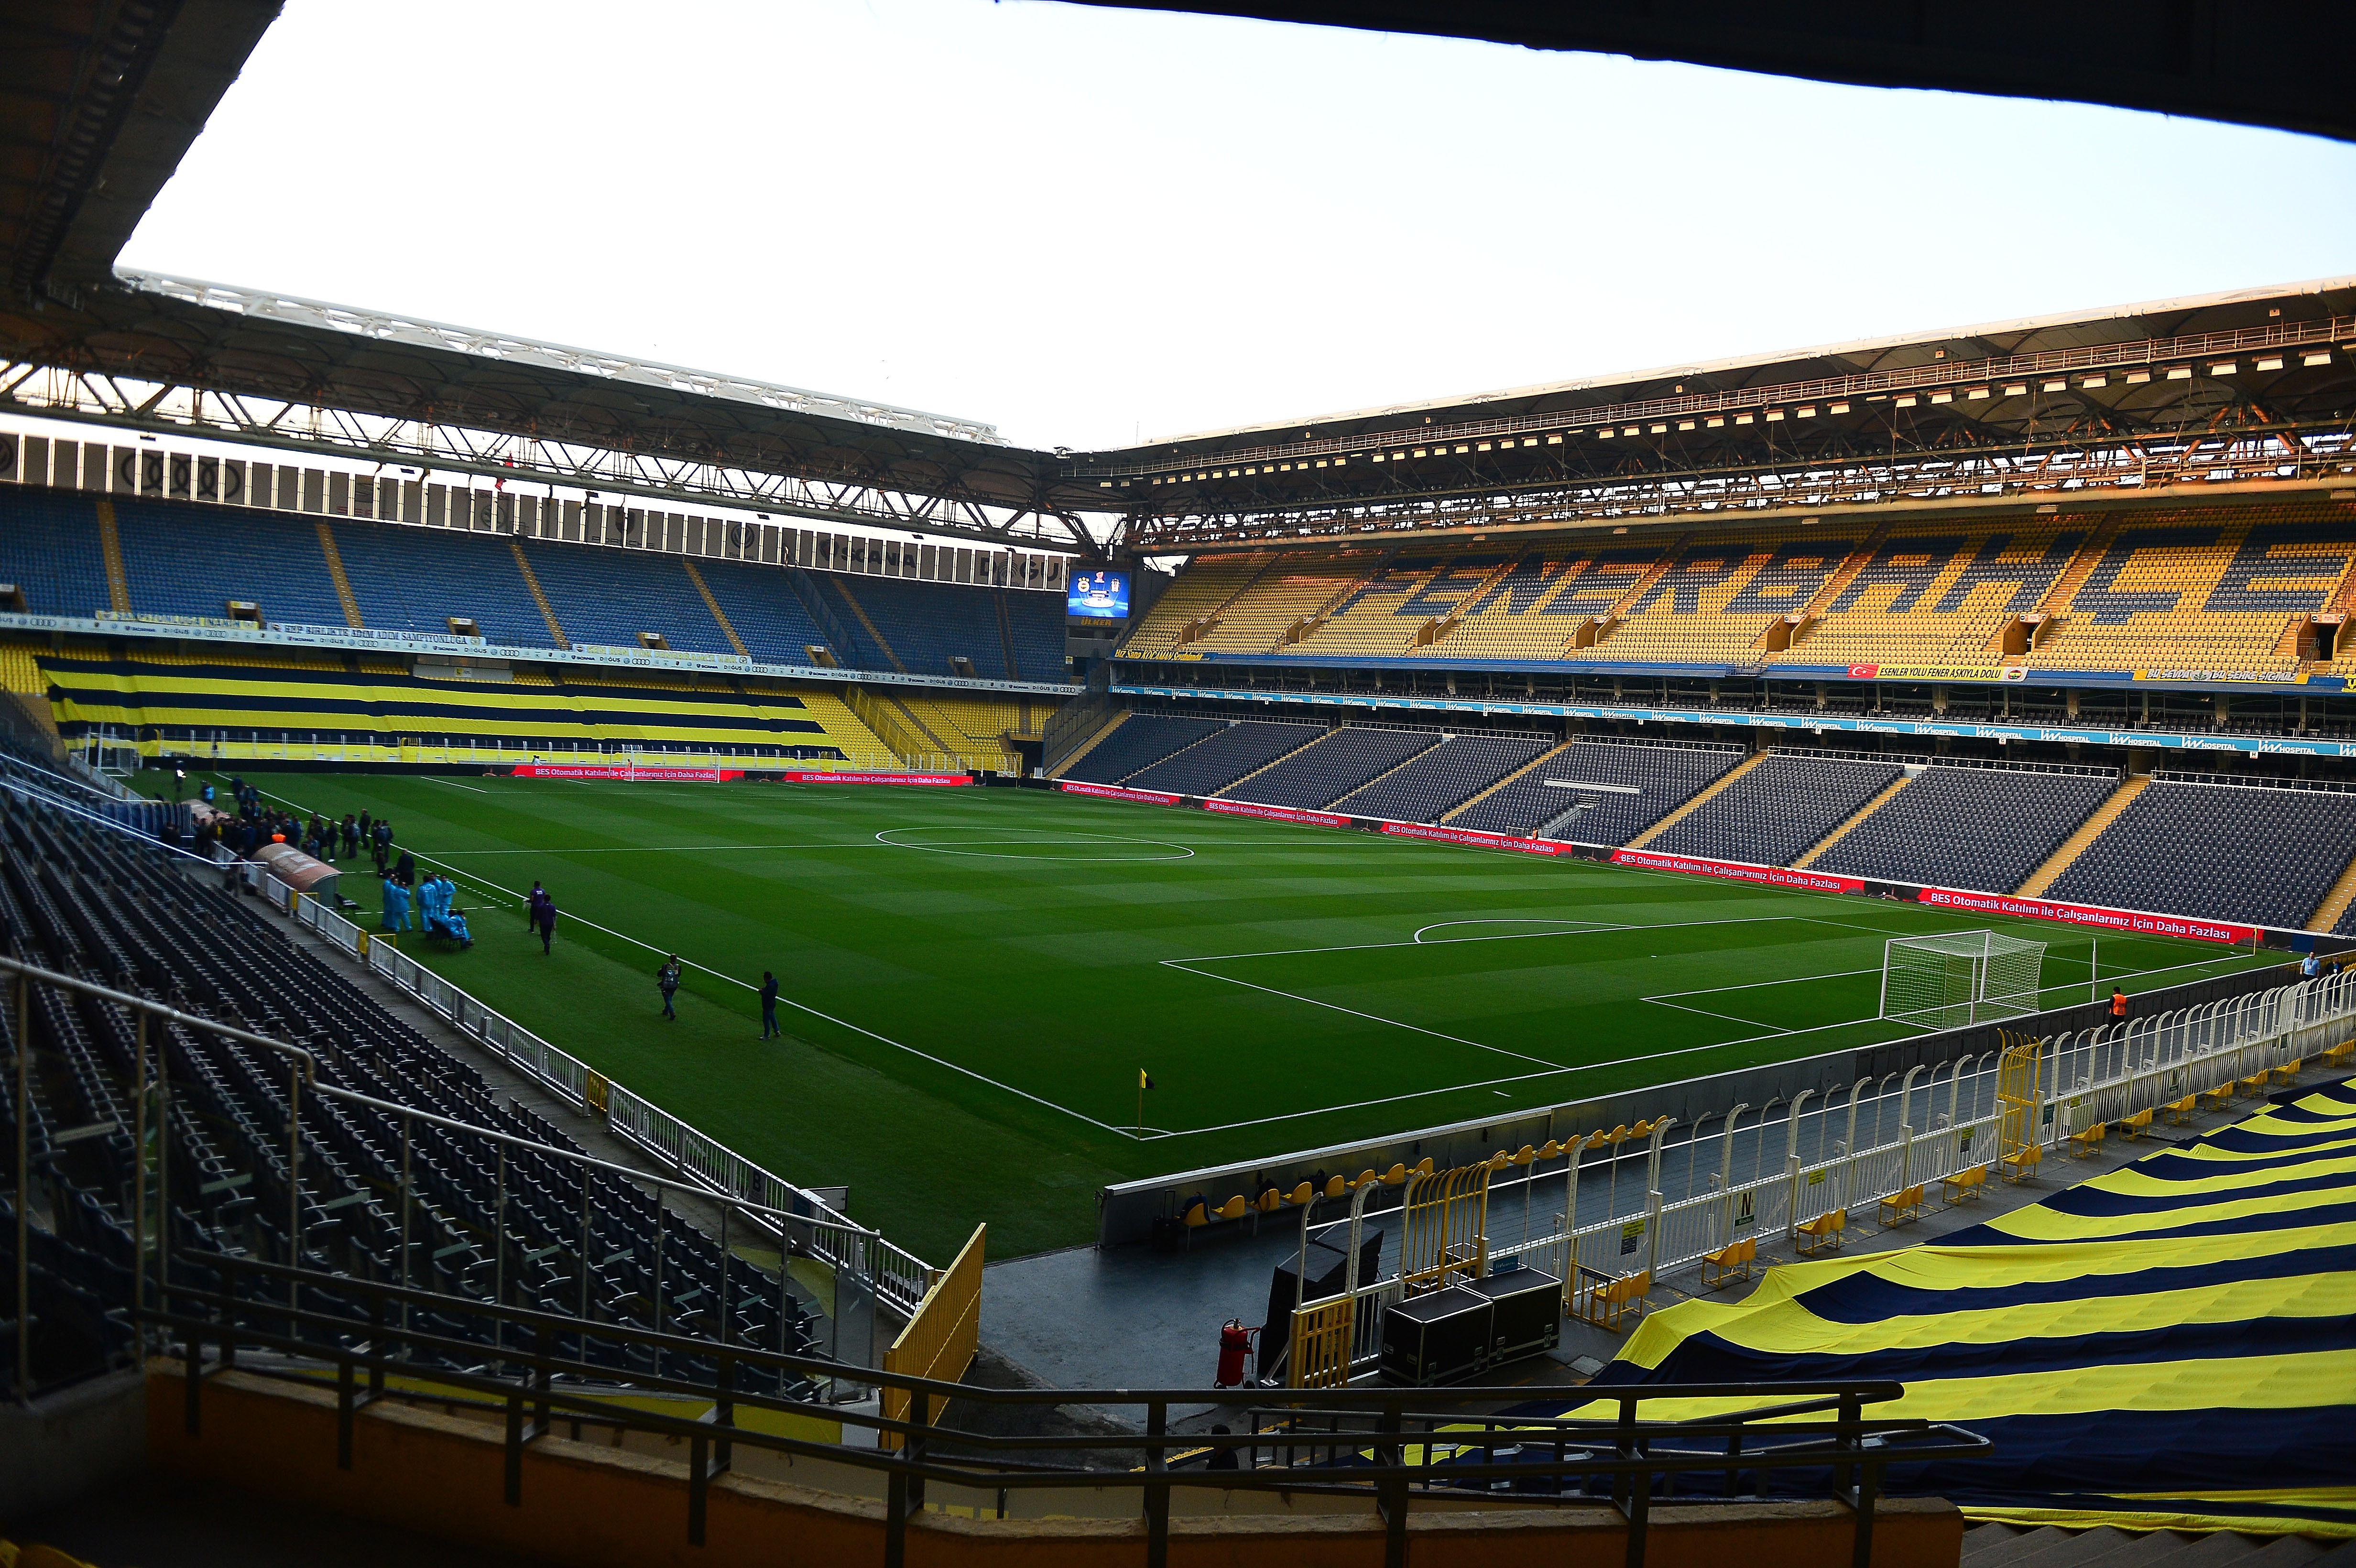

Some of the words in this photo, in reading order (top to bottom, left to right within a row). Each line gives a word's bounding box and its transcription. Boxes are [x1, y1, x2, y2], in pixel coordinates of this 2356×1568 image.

[841, 547, 916, 568] SCANIA
[1081, 617, 1112, 626] ÜLKER
[1879, 668, 1909, 676] ESENLER
[1927, 668, 1949, 677] FENER
[1950, 669, 1978, 679] AŞKIYLA
[1980, 669, 2001, 678] DOLU
[2128, 738, 2161, 746] HOSPITAL
[2279, 745, 2317, 754] HOSPITAL
[1264, 810, 1295, 819] Çalışanlarınız
[1296, 813, 1305, 821] İçin
[1306, 814, 1319, 822] Daha
[1401, 827, 1428, 836] Otomatik
[1429, 830, 1450, 839] Katılım
[1459, 834, 1499, 846] Çalışanlarınız
[1501, 837, 1512, 848] İçin
[1514, 841, 1530, 849] Daha
[1531, 843, 1554, 853] Fazlası
[1637, 856, 1672, 868] Otomatik
[1673, 860, 1701, 872] Katılım
[1702, 864, 1712, 873] ile
[1769, 871, 1785, 882] İçin
[1787, 874, 1808, 886] Daha
[1811, 878, 1840, 890] Fazlası
[1931, 893, 1950, 903] BES
[1952, 896, 1999, 909] Otomatik
[2002, 902, 2039, 915] Katılım
[2041, 906, 2054, 916] ile
[2057, 908, 2129, 926] Çalışanlarınız
[2133, 915, 2153, 931] İçin
[2156, 920, 2186, 935] Daha
[2189, 925, 2230, 939] Fazlası
[753, 1171, 761, 1192] B
[1741, 1191, 1752, 1217] N
